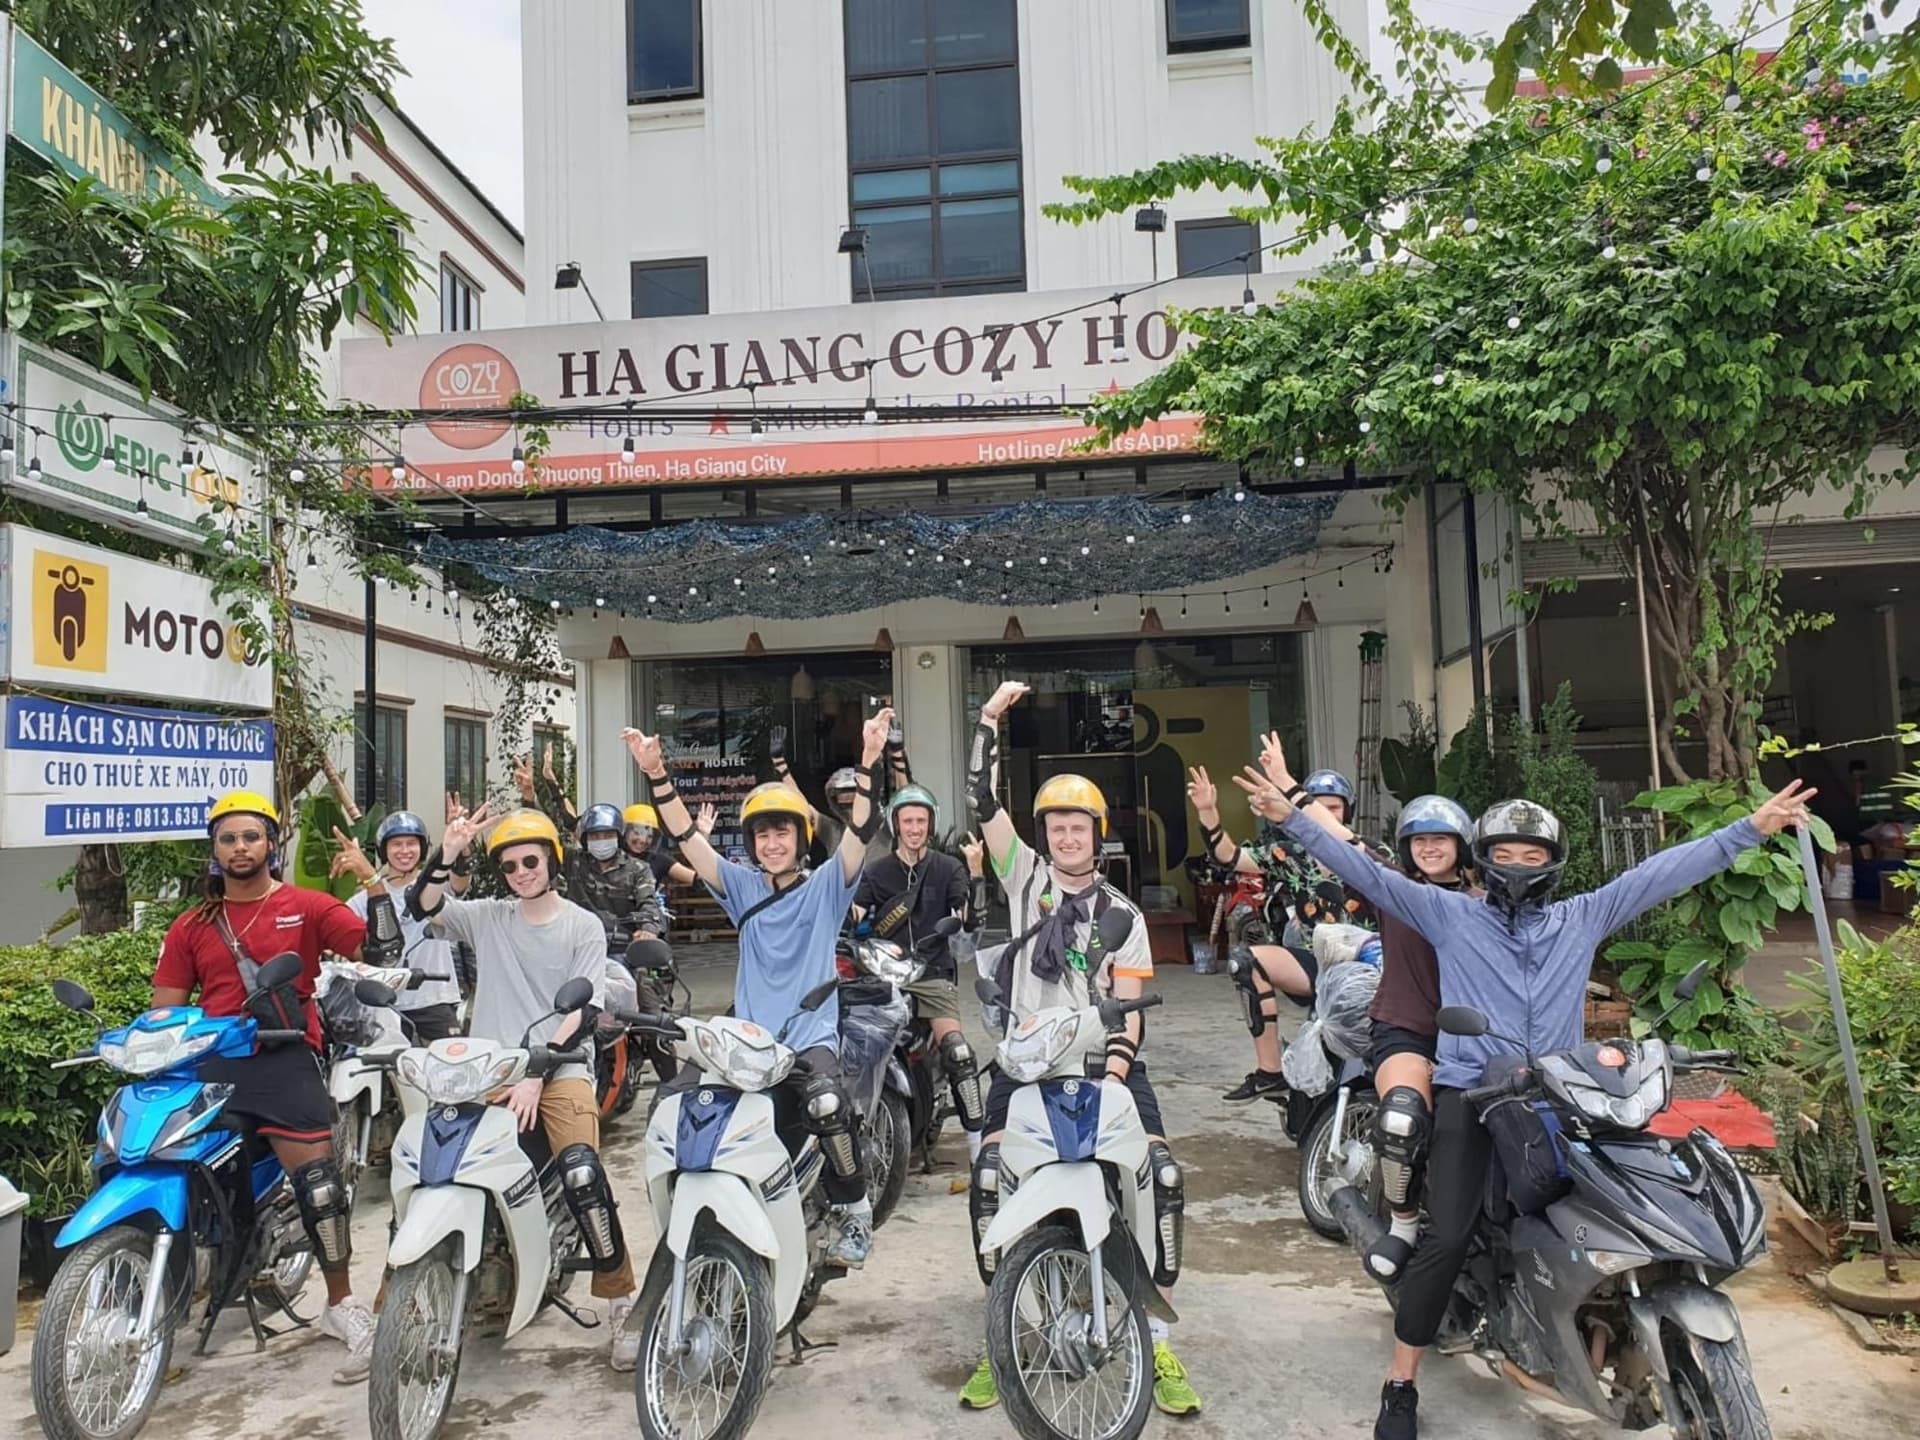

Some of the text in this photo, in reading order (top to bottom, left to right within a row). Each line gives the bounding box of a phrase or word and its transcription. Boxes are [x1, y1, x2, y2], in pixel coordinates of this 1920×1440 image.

[558, 348, 646, 399] HA
[664, 333, 866, 393] GIANG
[889, 318, 1063, 378] COZY
[436, 361, 500, 396] COZY
[114, 433, 171, 492] EPIC
[478, 469, 528, 490] Dong,
[606, 461, 661, 479] Thien,
[665, 458, 690, 476] Ha
[694, 456, 747, 476] Giang
[751, 453, 787, 474] City
[18, 705, 105, 745] KHÁCH
[111, 718, 155, 754] SẠN
[160, 715, 199, 749] CÒN
[45, 758, 248, 790] CHO THUÊ XE MÁY, ÔTÔ
[704, 757, 747, 769] HOSTEL
[673, 777, 698, 788] Tour
[65, 807, 101, 830] Liên
[106, 807, 130, 833] Hệ:
